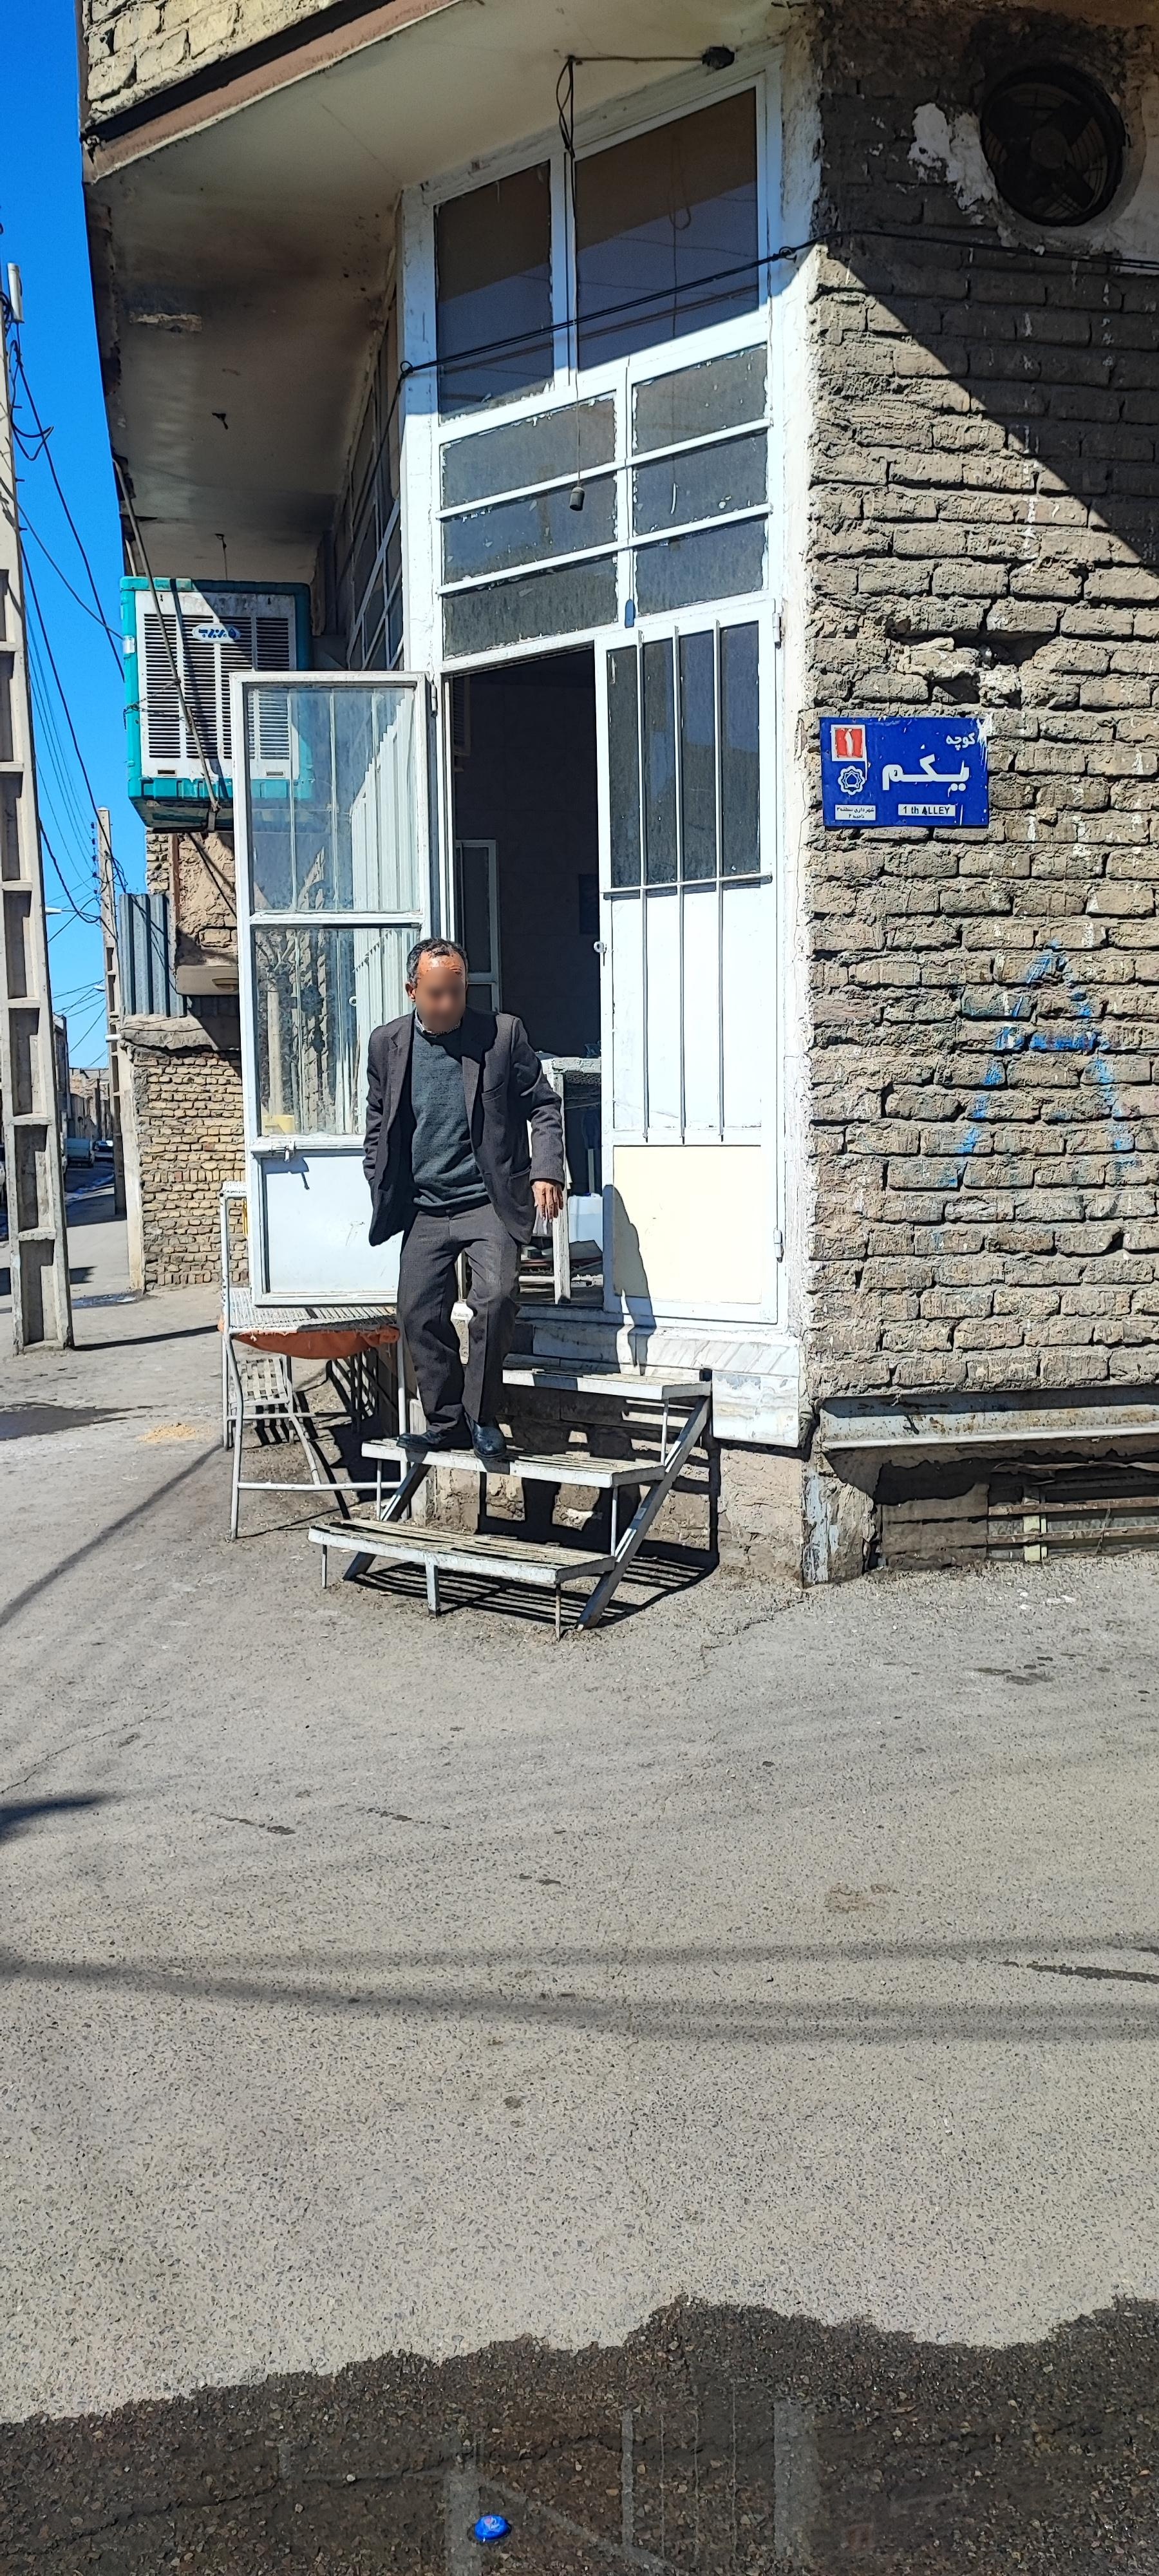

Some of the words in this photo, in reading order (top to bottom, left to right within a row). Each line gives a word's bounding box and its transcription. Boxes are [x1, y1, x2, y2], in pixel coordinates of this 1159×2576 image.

[945, 732, 975, 751] کوچه
[882, 754, 970, 791] یکم
[903, 806, 907, 815] 1
[910, 806, 919, 815] th
[921, 806, 950, 815] ALLEY
